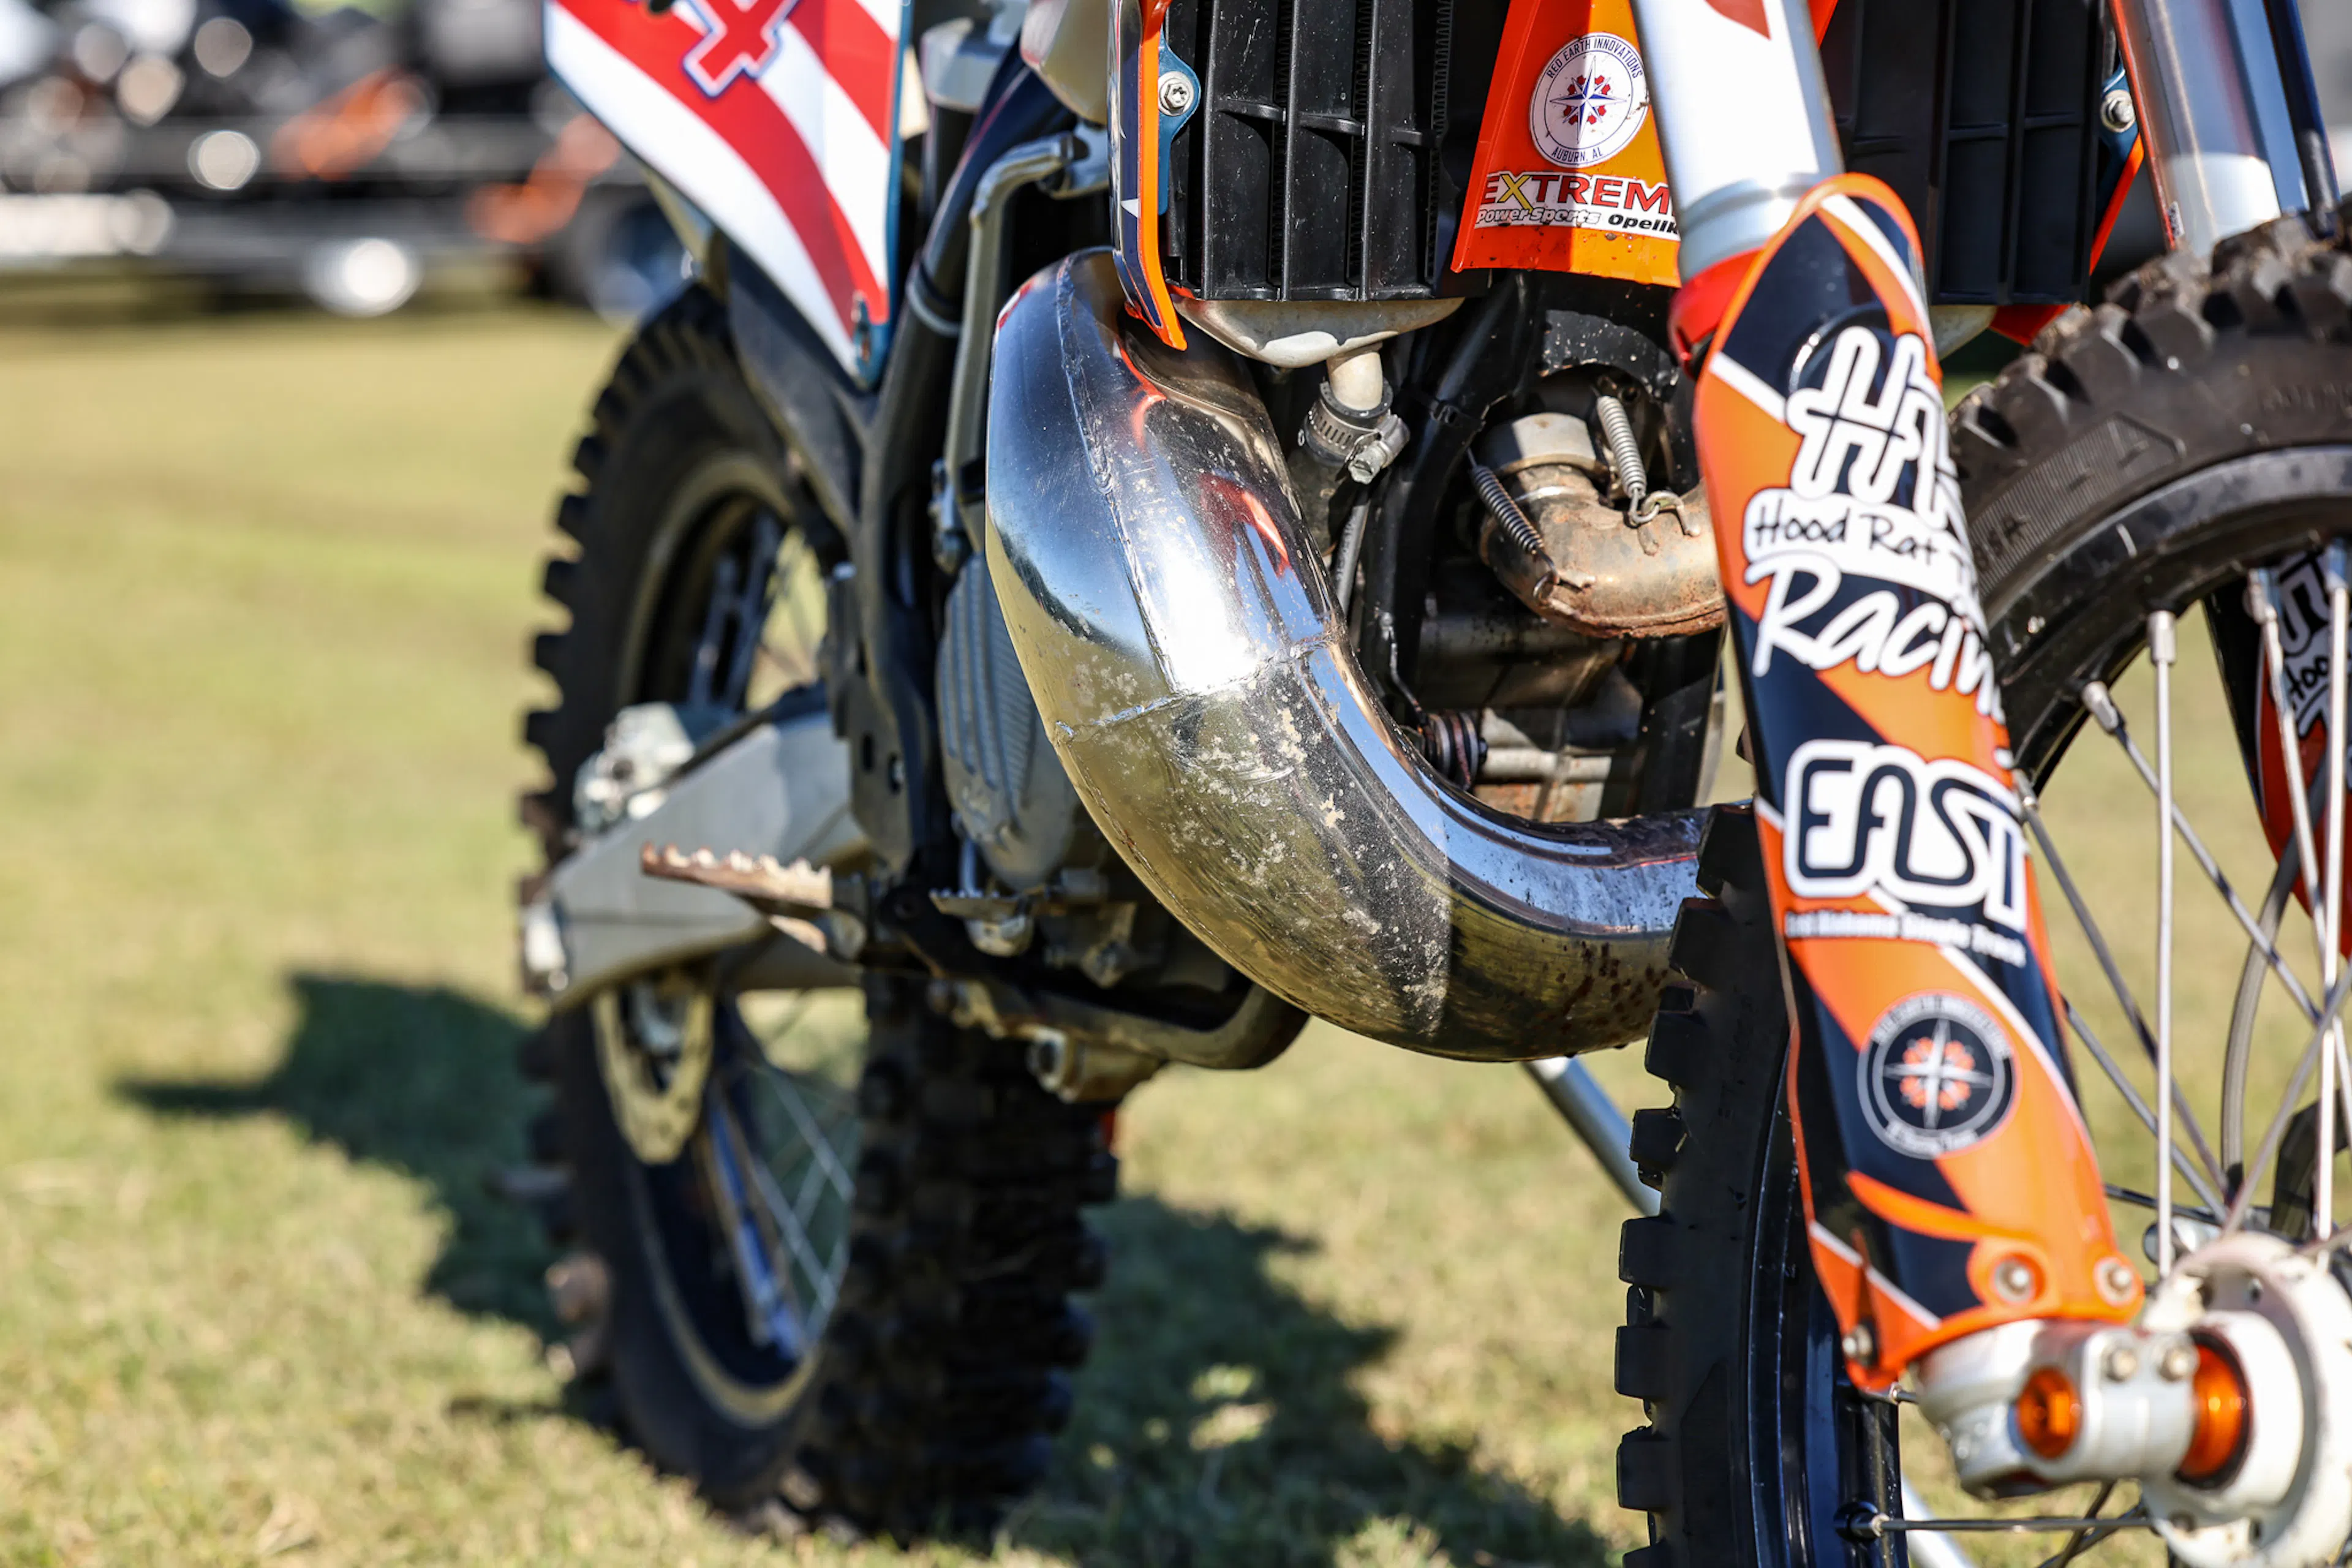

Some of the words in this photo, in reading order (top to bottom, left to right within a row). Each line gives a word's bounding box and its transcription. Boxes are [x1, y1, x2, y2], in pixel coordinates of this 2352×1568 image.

[1545, 59, 1562, 78] RED
[1563, 39, 1591, 61] EARTH
[1594, 37, 1643, 78] INNOVATIONS
[1593, 146, 1603, 159] AL
[1480, 173, 1674, 216] EXTREM
[1754, 497, 1850, 547] Hood
[1857, 513, 1937, 565] Rat
[1744, 554, 2004, 724] Racin
